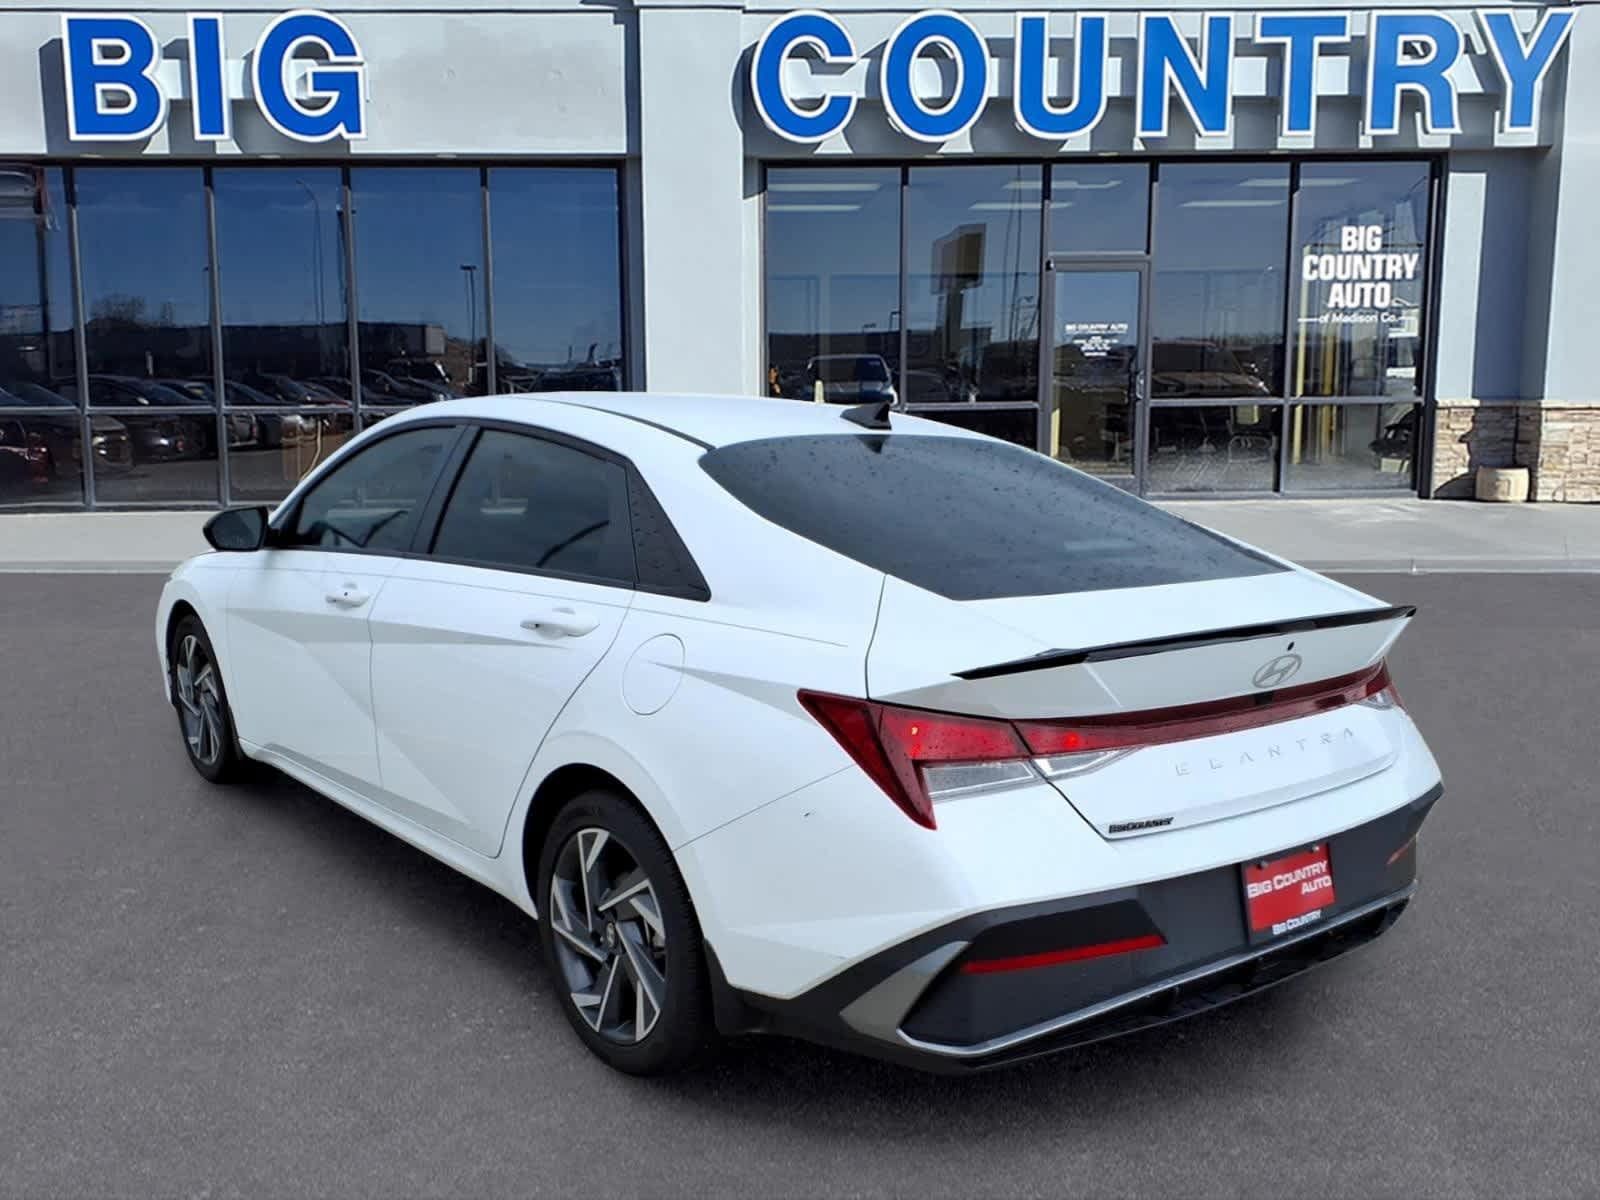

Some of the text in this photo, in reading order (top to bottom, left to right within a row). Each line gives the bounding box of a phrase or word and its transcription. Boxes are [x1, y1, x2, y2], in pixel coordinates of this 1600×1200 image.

[61, 6, 1573, 143] BIG COUNTRY
[1341, 225, 1382, 252] BIG
[1302, 253, 1419, 281] COUNTRY
[1327, 282, 1391, 309] AUTO
[1319, 312, 1330, 323] of
[1331, 312, 1378, 323] Madison
[1174, 727, 1354, 777] ELANTRA
[1247, 860, 1328, 899] BIG COUNTRY
[1301, 875, 1333, 895] AUTO
